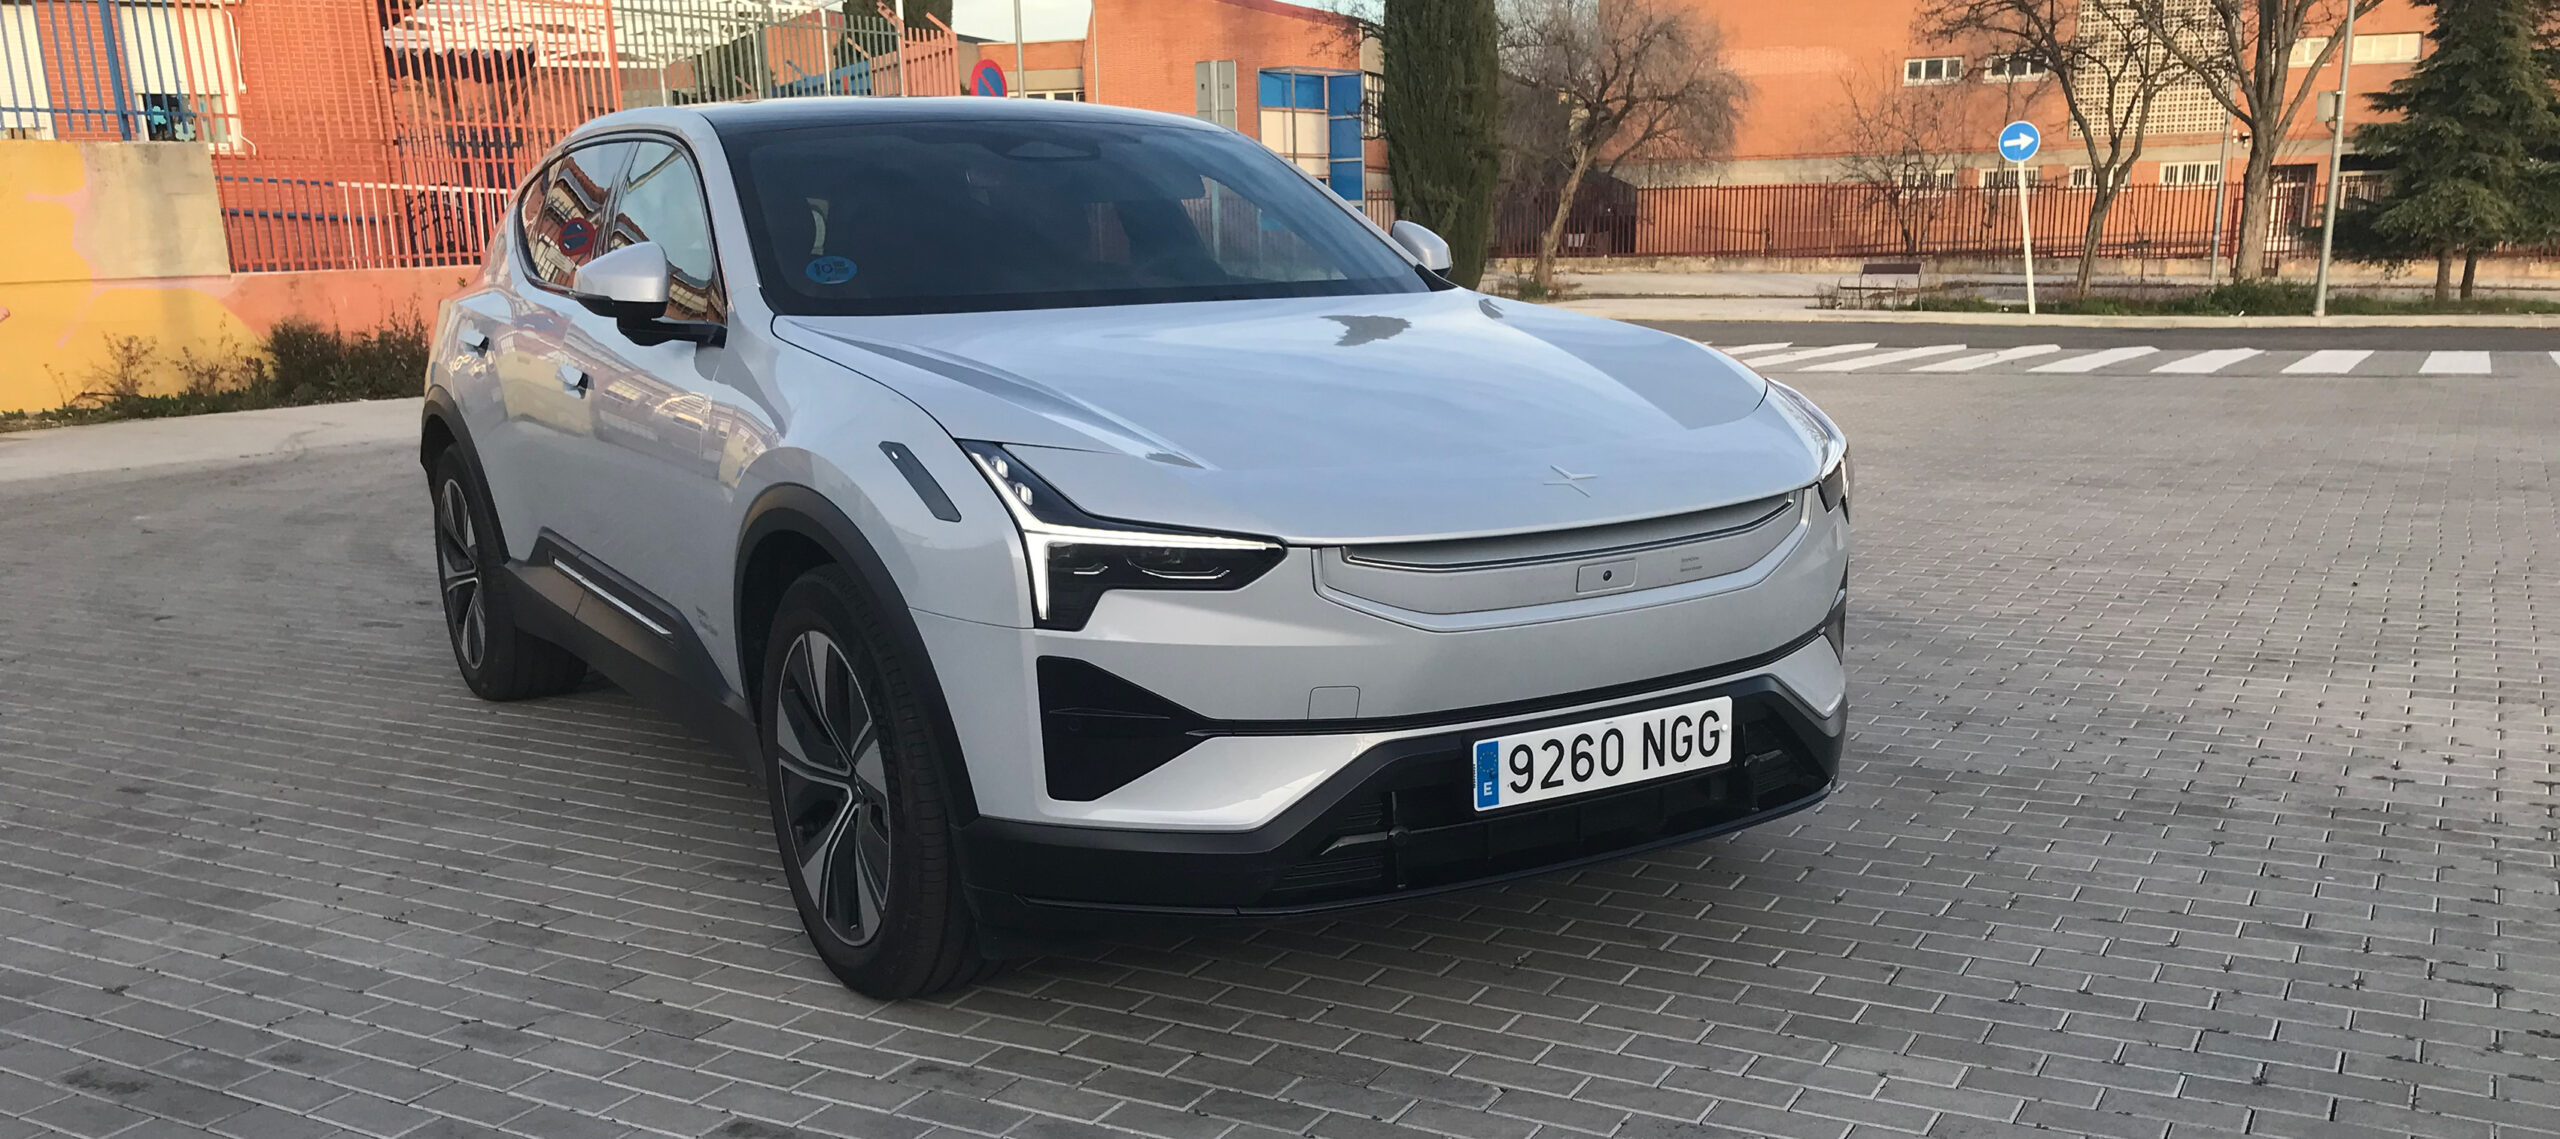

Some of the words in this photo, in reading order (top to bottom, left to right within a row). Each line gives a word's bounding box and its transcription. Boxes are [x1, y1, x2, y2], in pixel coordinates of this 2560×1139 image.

[1508, 728, 1624, 793] 9260
[1642, 710, 1720, 770] NGG
[1483, 781, 1493, 796] E
